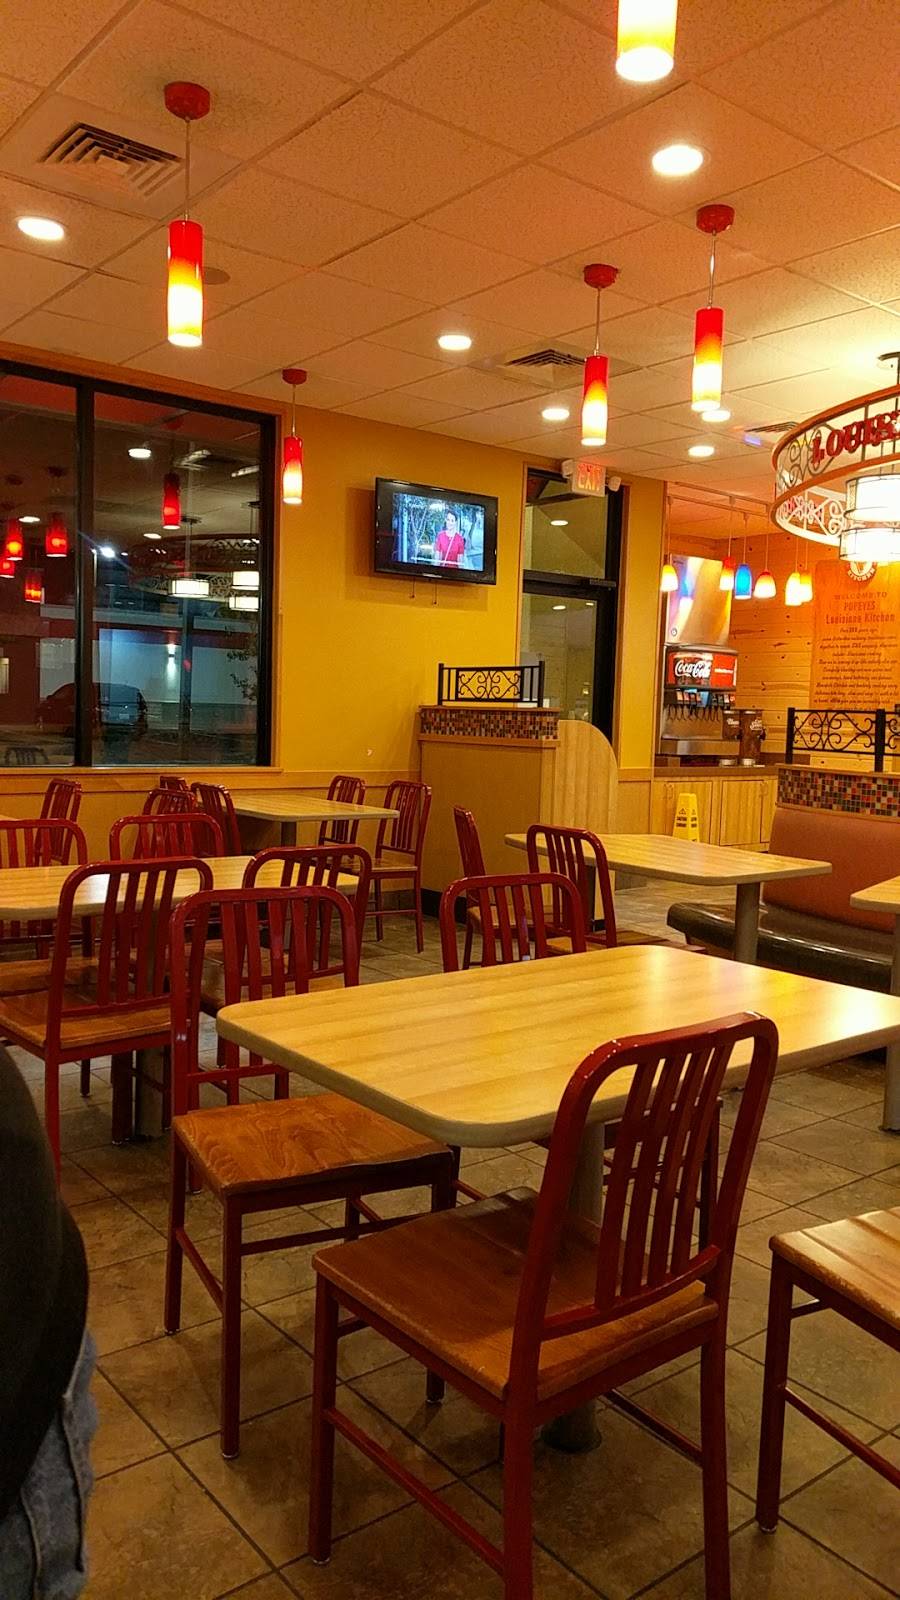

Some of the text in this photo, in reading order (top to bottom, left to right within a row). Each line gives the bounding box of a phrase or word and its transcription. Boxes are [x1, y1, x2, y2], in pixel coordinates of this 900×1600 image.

[577, 464, 601, 491] EXIT
[844, 601, 876, 611] POPEYES
[826, 613, 896, 625] Louisiana Kitchen
